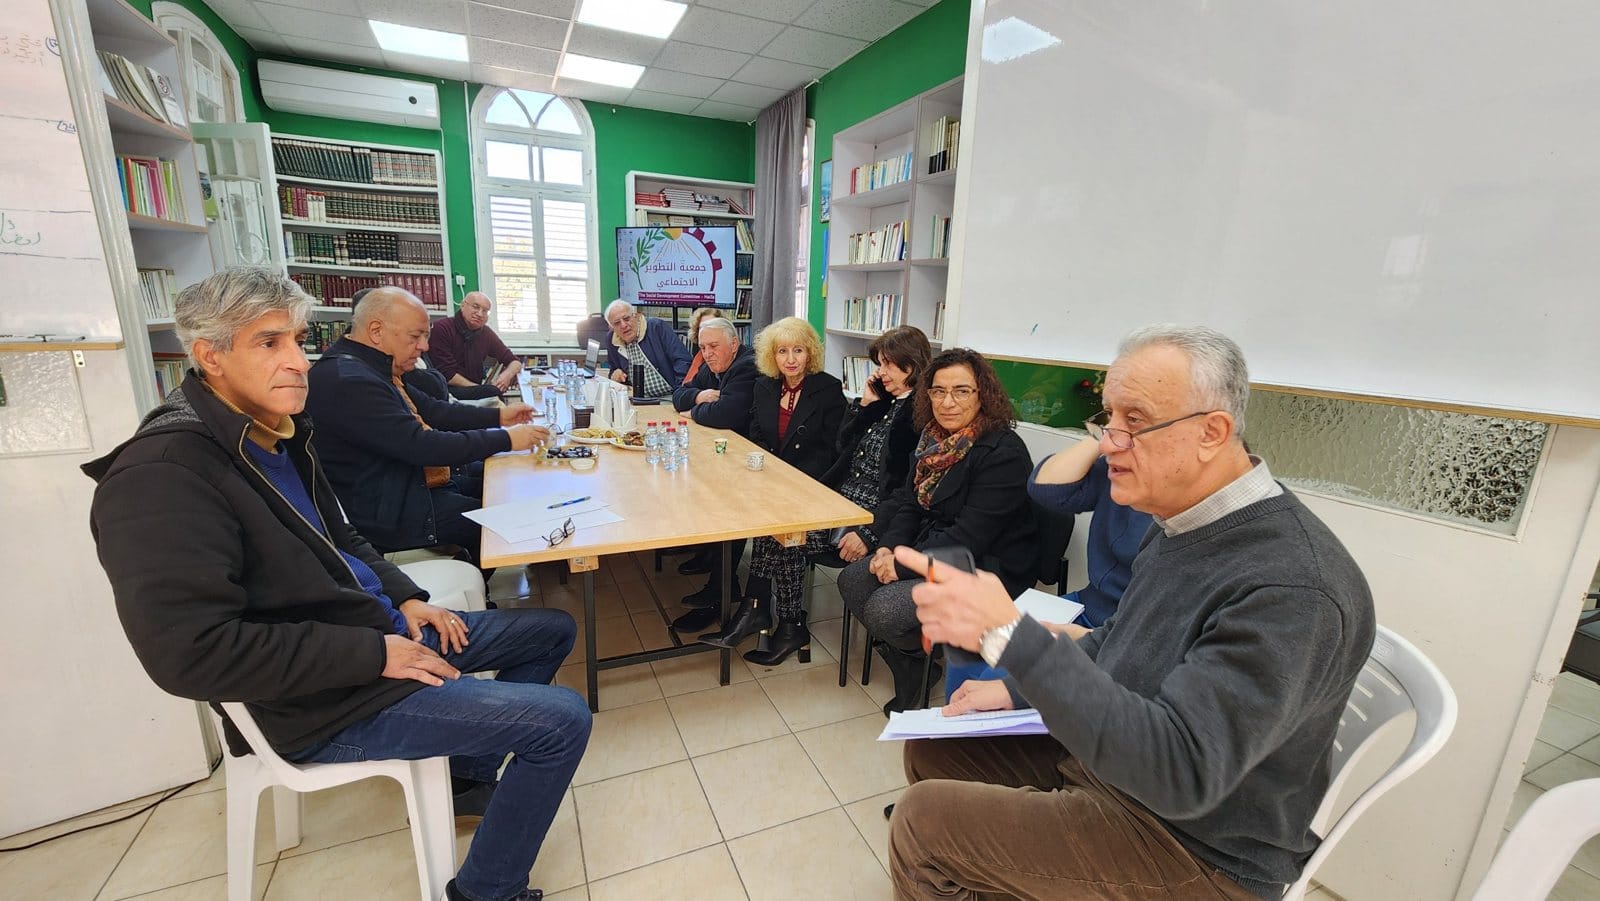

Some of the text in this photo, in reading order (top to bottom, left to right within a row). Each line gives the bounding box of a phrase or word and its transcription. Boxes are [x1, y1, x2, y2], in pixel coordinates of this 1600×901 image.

[645, 262, 706, 274] جمعية التطوير
[657, 277, 698, 290] الاجتماعي
